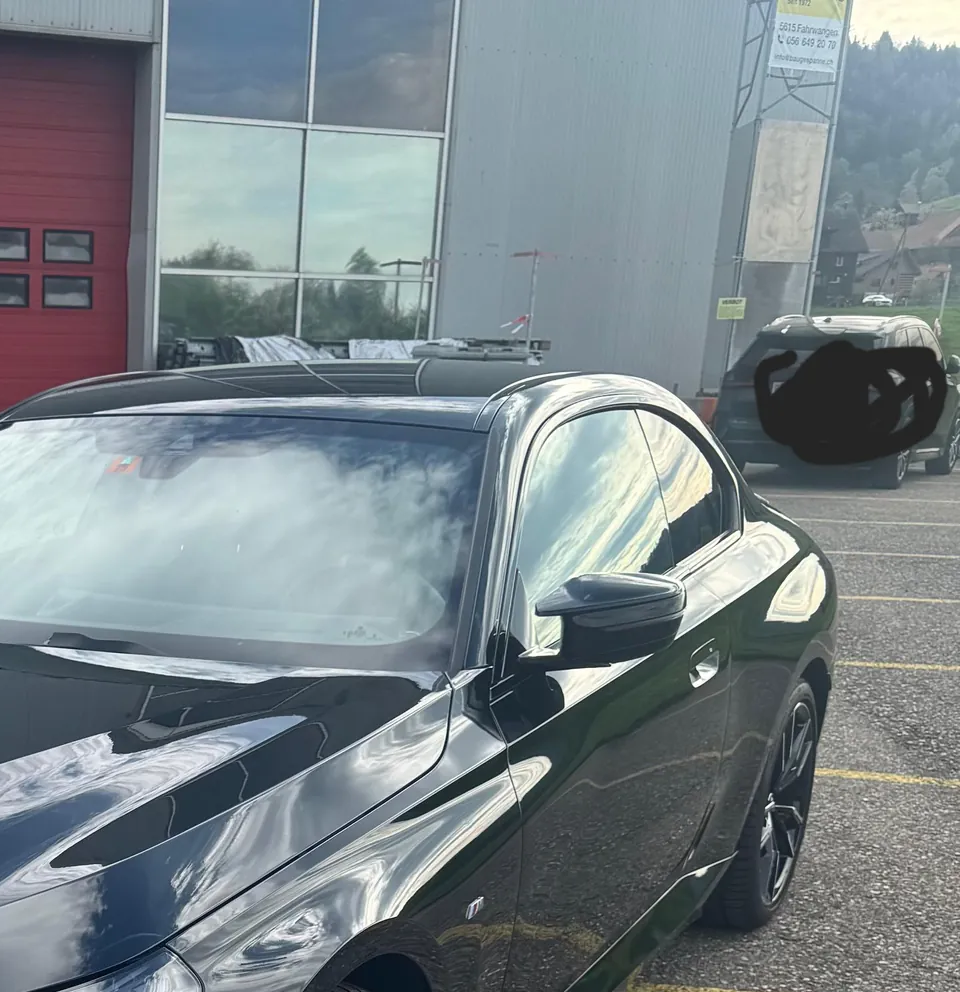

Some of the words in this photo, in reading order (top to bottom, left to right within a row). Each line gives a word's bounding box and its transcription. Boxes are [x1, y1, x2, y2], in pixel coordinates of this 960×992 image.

[779, 22, 796, 32] 5615
[797, 23, 839, 38] Fahrwangen
[786, 36, 800, 46] 056
[801, 37, 815, 48] 649
[816, 39, 826, 49] 20
